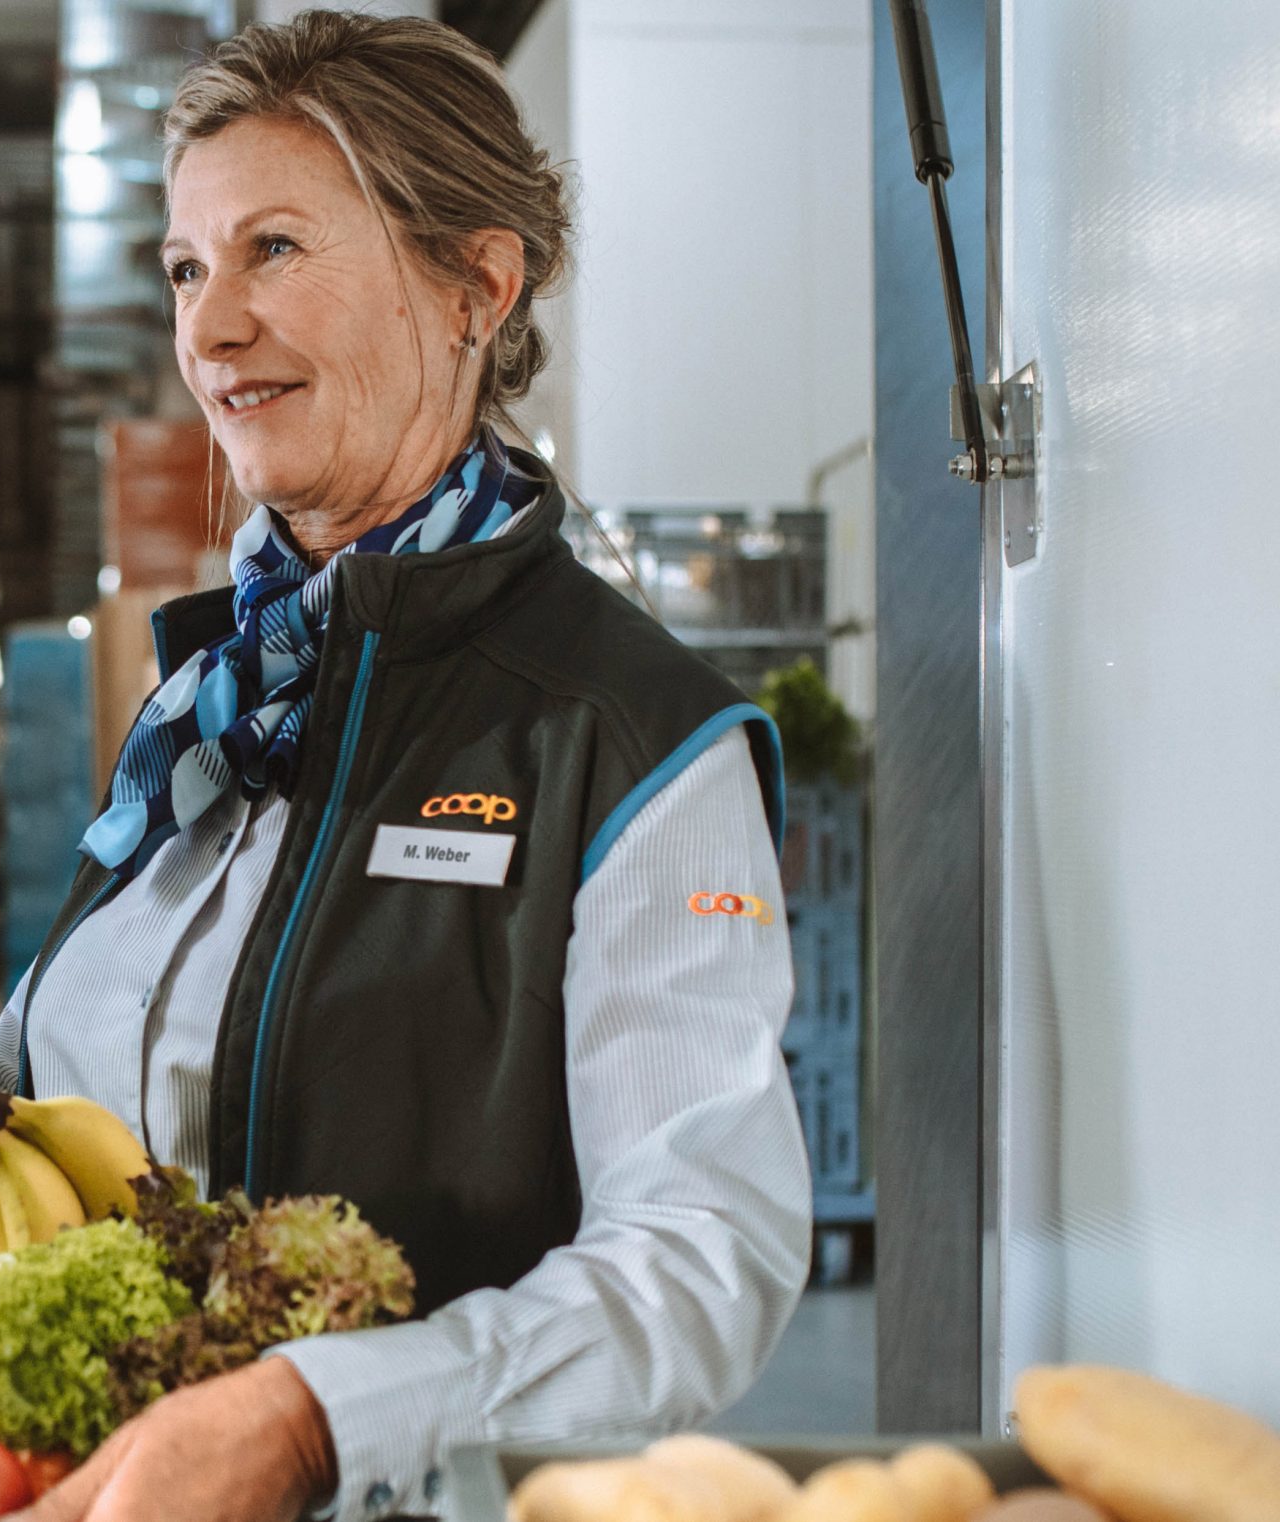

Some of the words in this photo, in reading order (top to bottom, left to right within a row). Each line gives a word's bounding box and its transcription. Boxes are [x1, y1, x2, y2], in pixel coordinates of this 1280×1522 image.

[421, 793, 517, 824] coop
[403, 845, 421, 860] M.
[425, 846, 471, 863] Weber
